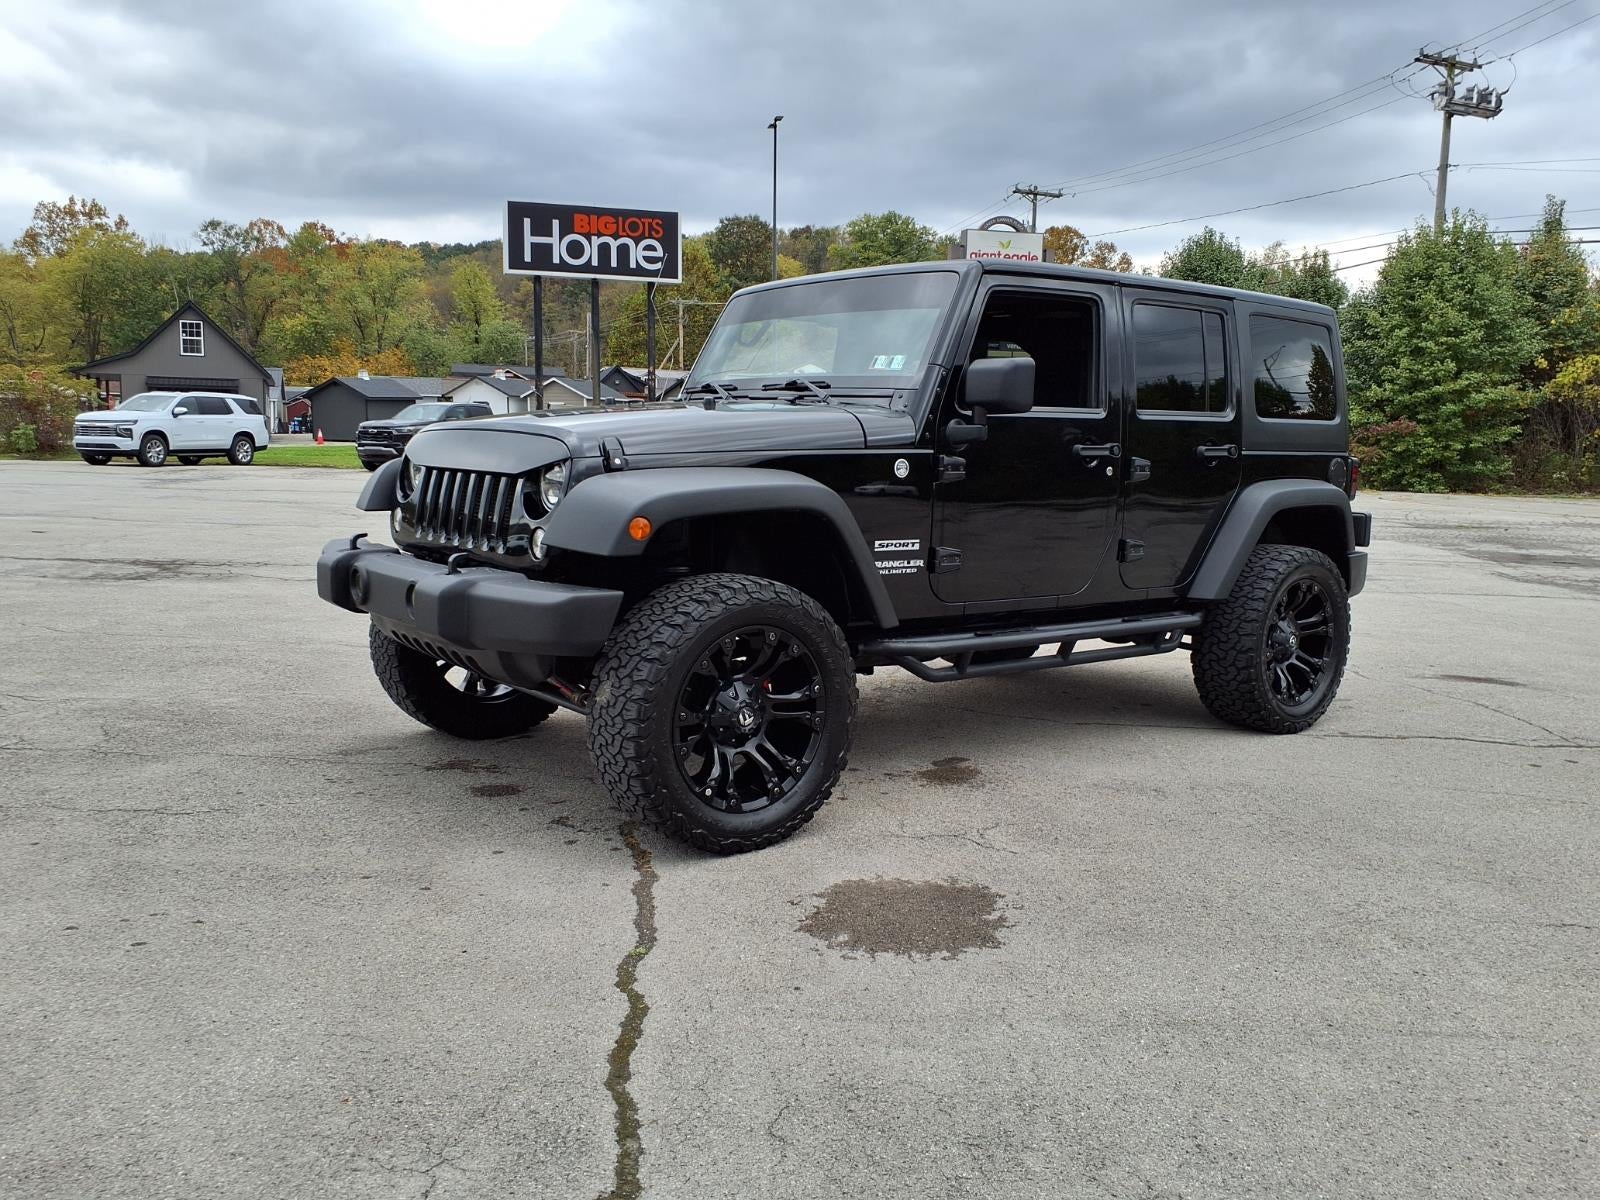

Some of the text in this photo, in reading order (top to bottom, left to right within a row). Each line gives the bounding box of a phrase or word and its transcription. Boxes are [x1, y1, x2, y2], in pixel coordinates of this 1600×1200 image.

[573, 213, 664, 238] BIG LOTS
[523, 217, 664, 270] Home
[877, 541, 917, 549] SPORT
[875, 560, 924, 568] RANGLER
